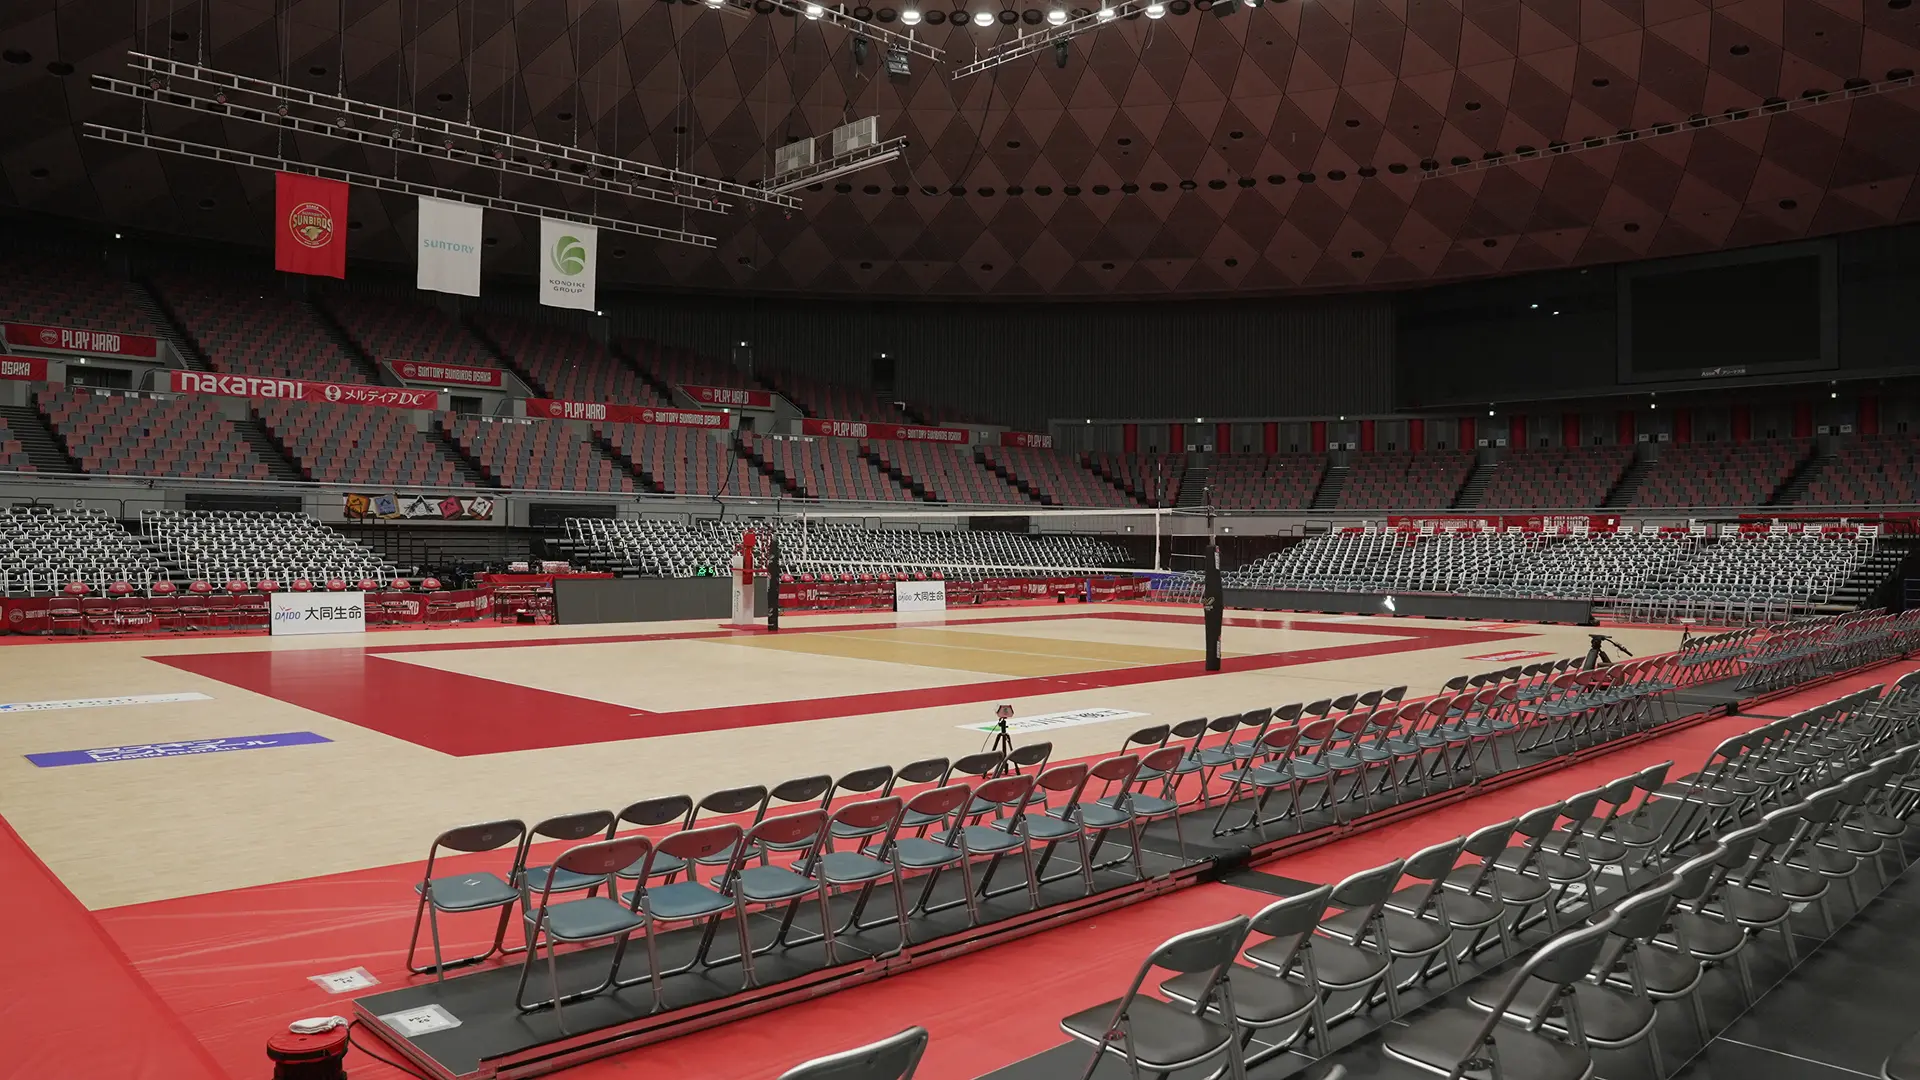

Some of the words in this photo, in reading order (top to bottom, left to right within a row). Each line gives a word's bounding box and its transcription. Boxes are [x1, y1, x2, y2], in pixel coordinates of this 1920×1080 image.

[292, 214, 333, 232] SUNBIRDS
[423, 239, 475, 253] SUNTORY
[553, 285, 583, 293] GROUP
[61, 329, 90, 349] PLAY
[91, 333, 121, 352] HARD
[1, 360, 31, 377] OSAKA
[417, 365, 445, 379] SUNTORY
[445, 368, 473, 382] SUNBIRDS
[714, 388, 731, 403] PLAY
[564, 401, 585, 419] PLAY
[585, 403, 606, 420] HARD
[833, 421, 850, 437] PLAY
[850, 423, 868, 438] HARD
[913, 590, 944, 601] 大同生命
[304, 605, 362, 621] 大同生命
